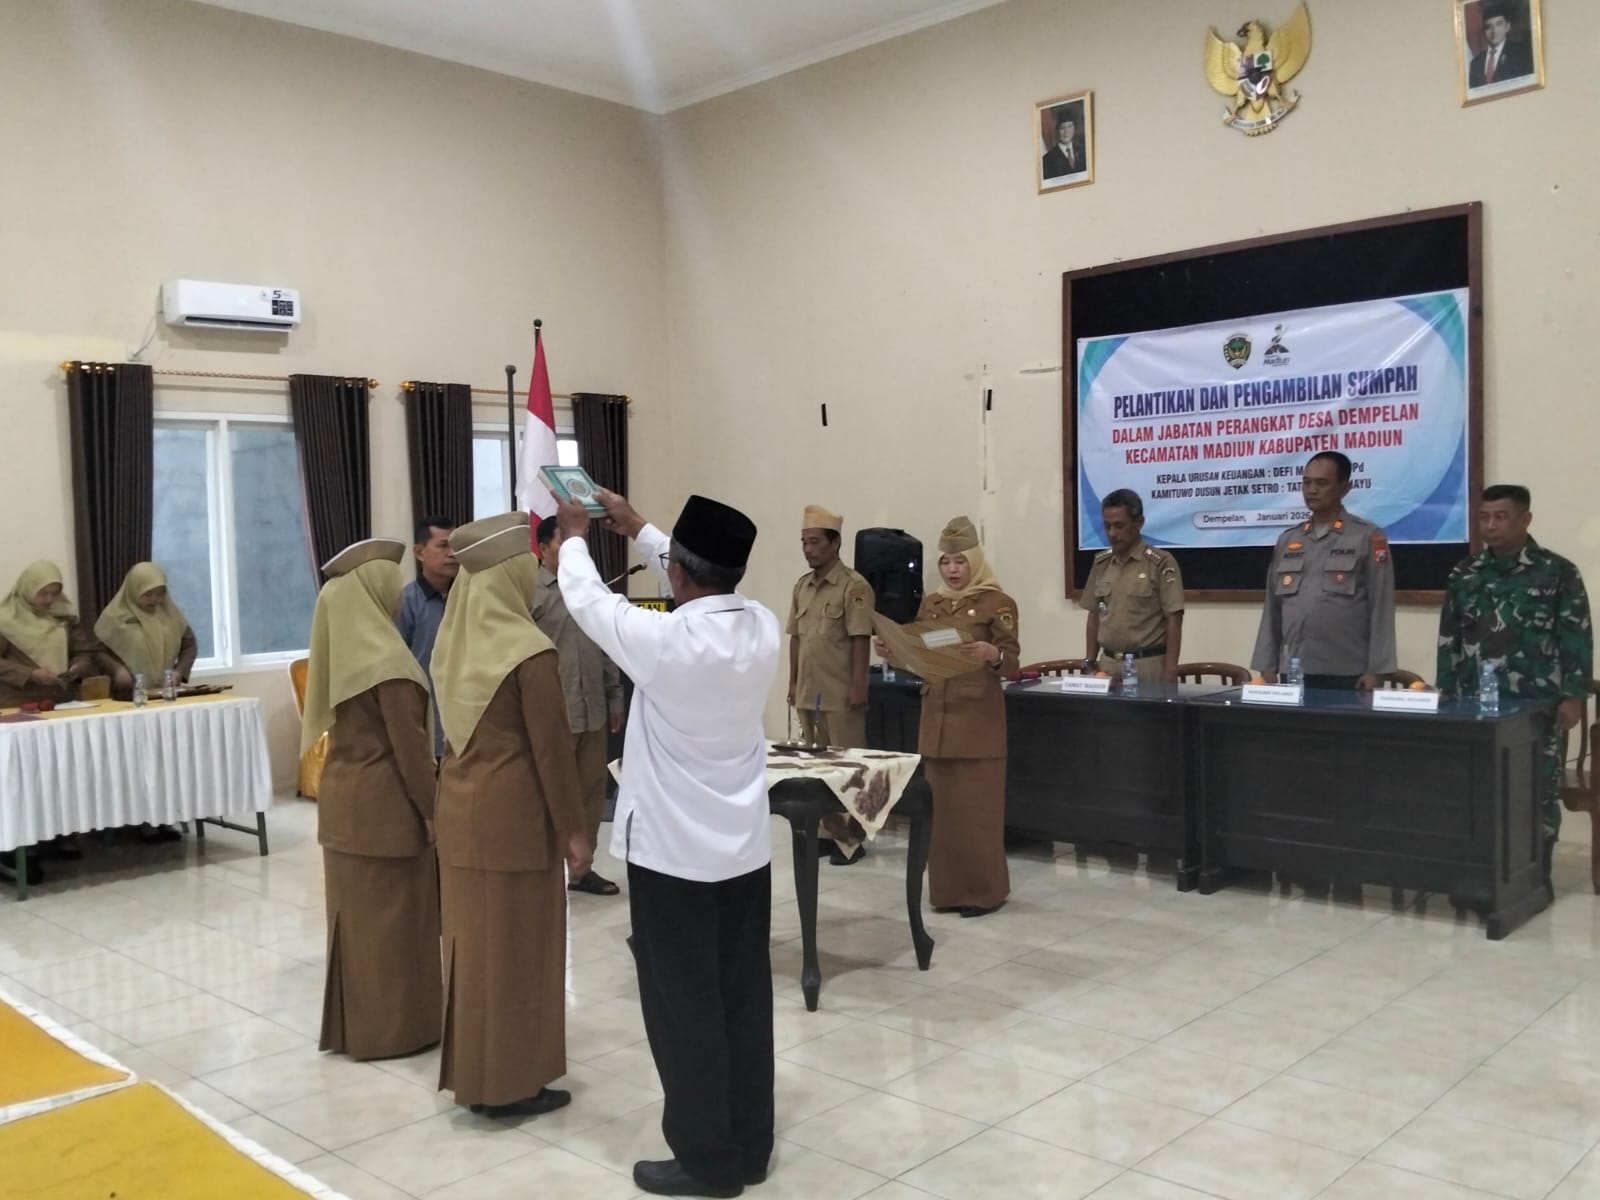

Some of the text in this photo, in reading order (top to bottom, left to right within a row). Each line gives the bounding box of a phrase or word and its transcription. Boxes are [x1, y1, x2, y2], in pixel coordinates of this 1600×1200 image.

[1114, 365, 1417, 418] PELANTIKAN DAN PENGAMBILAN SUMPAH
[1113, 403, 1419, 443] DALAM JABATAN PERANGKAT DESA DEMPELAN
[1126, 429, 1402, 465] KECAMATAN MADIUN KABUPATEN MADIUN
[1156, 474, 1187, 485] KEPALA
[1188, 471, 1219, 483] URUSAN
[1221, 467, 1266, 481] KEUANGAN
[1273, 466, 1293, 478] DEFI
[1151, 486, 1193, 500] KAMITUWO
[1195, 484, 1221, 497] DUSUN
[1223, 483, 1249, 496] JETAK
[1251, 481, 1279, 494] SETRO
[1287, 481, 1301, 493] TAT
[1203, 513, 1247, 524] Dempelan,
[1255, 511, 1289, 521] Januari
